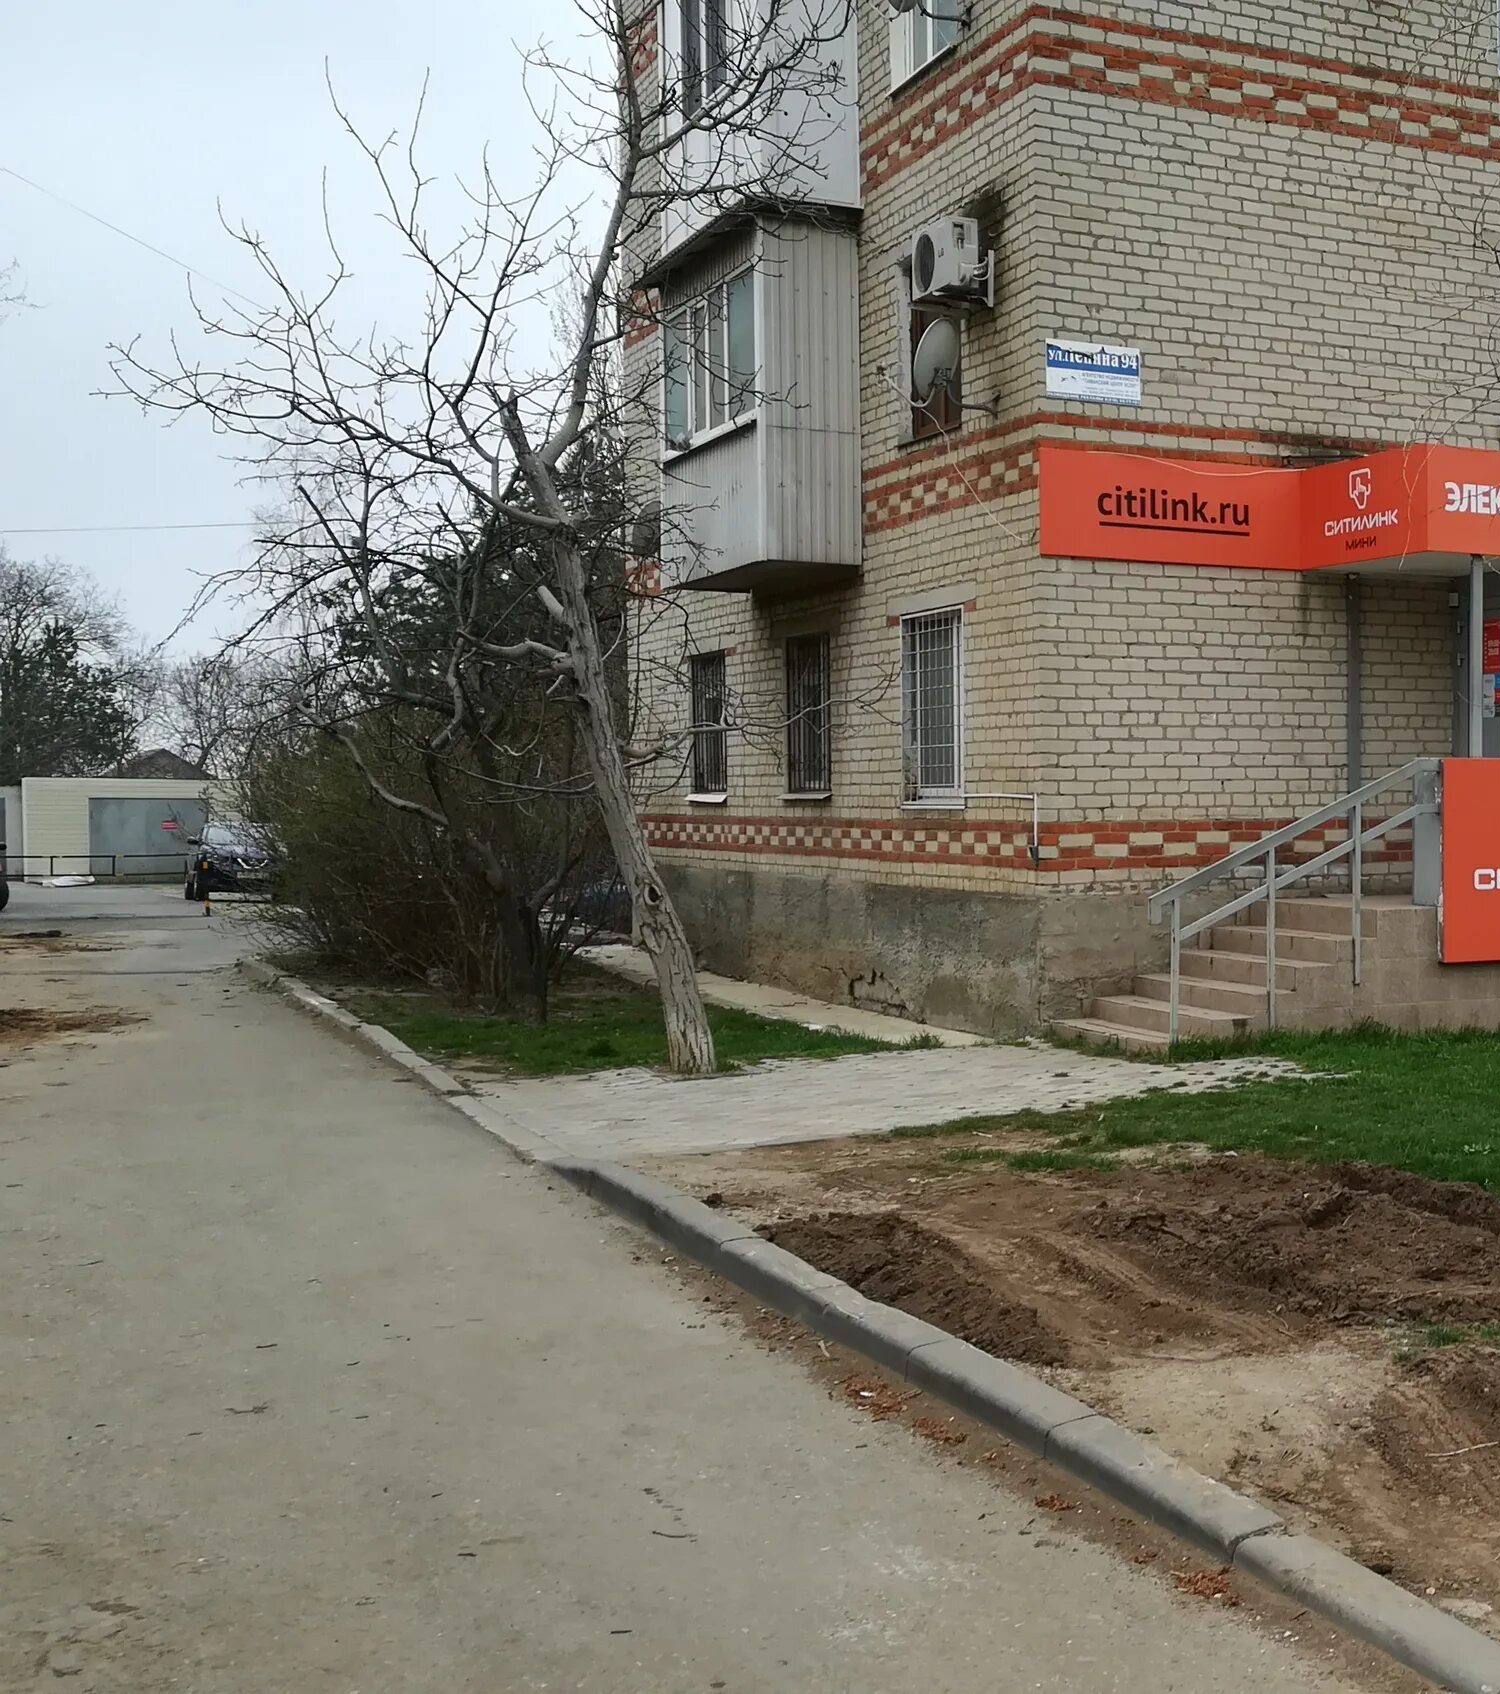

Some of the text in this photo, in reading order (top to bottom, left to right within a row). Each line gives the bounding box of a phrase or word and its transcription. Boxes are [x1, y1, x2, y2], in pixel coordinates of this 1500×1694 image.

[1121, 354, 1138, 370] 94
[1097, 485, 1249, 527] citilink.ru
[1324, 508, 1399, 537] СИТИЛИНК
[1345, 536, 1377, 551] МИНИ
